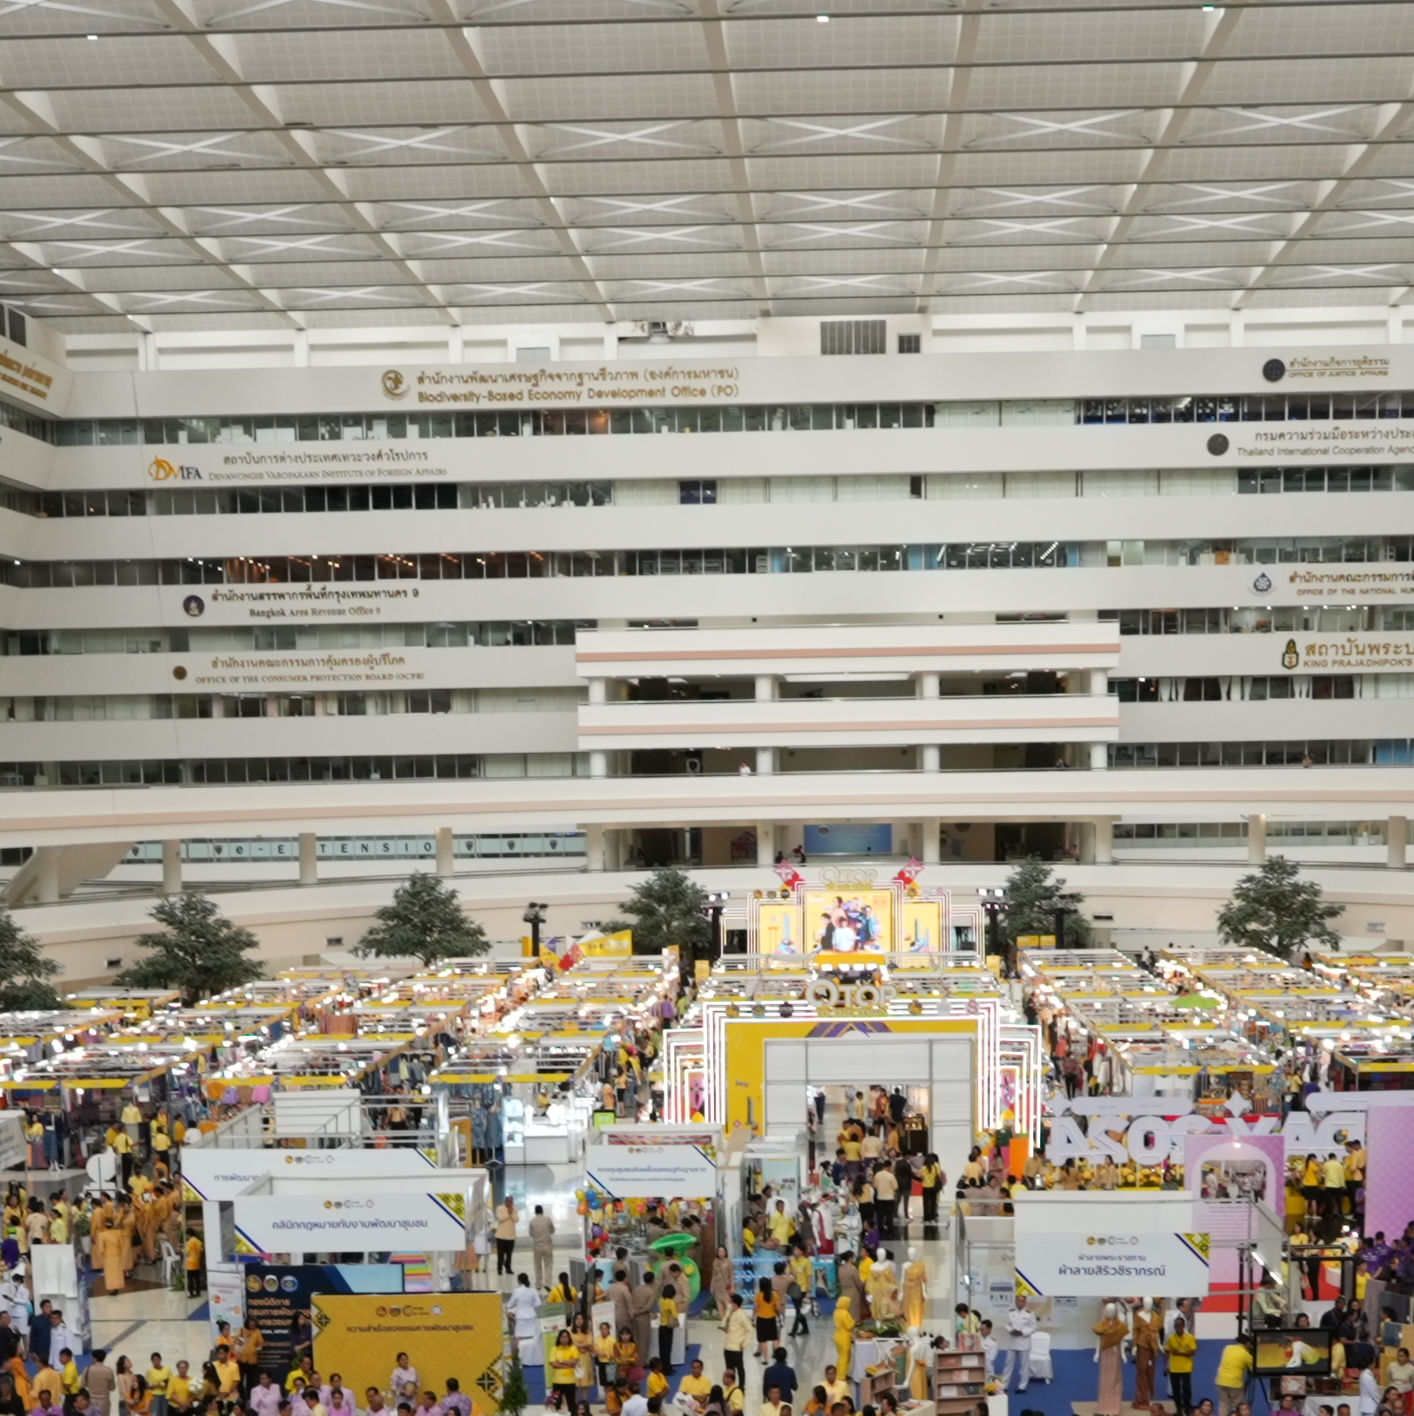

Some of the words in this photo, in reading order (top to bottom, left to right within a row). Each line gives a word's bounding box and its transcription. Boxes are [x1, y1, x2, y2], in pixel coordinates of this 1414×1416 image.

[1288, 371, 1315, 379] OFFICE
[1327, 370, 1358, 378] JUSTICE
[418, 387, 524, 404] Biodiversity-Based
[528, 386, 583, 403] Economy
[588, 385, 667, 402] Development
[671, 384, 707, 398] Office
[710, 383, 740, 399] (PO)
[1237, 446, 1275, 457] Thailand
[1277, 445, 1330, 456] International
[1332, 445, 1386, 457] Cooperation
[212, 585, 408, 604] สำนักงานสรรพากรพื้นที่กรุงเทพมหานคร
[1296, 588, 1324, 596] OFFICE
[1359, 587, 1397, 595] NATIONAL
[249, 608, 287, 619] Bangkok
[289, 608, 309, 618] Area
[311, 607, 347, 617] Revenue
[349, 606, 375, 616] Office
[212, 653, 406, 671] สำนักงานคณะกรรมการคุ้มครองผู้บริโภค
[1303, 659, 1328, 668] KING
[1332, 658, 1413, 668] PRAJADHIPOK'S
[195, 676, 227, 684] OFFICE
[229, 676, 241, 684] OF
[242, 675, 260, 683] THE
[261, 675, 308, 683] CONSUMER
[310, 674, 364, 682] PROTECTION
